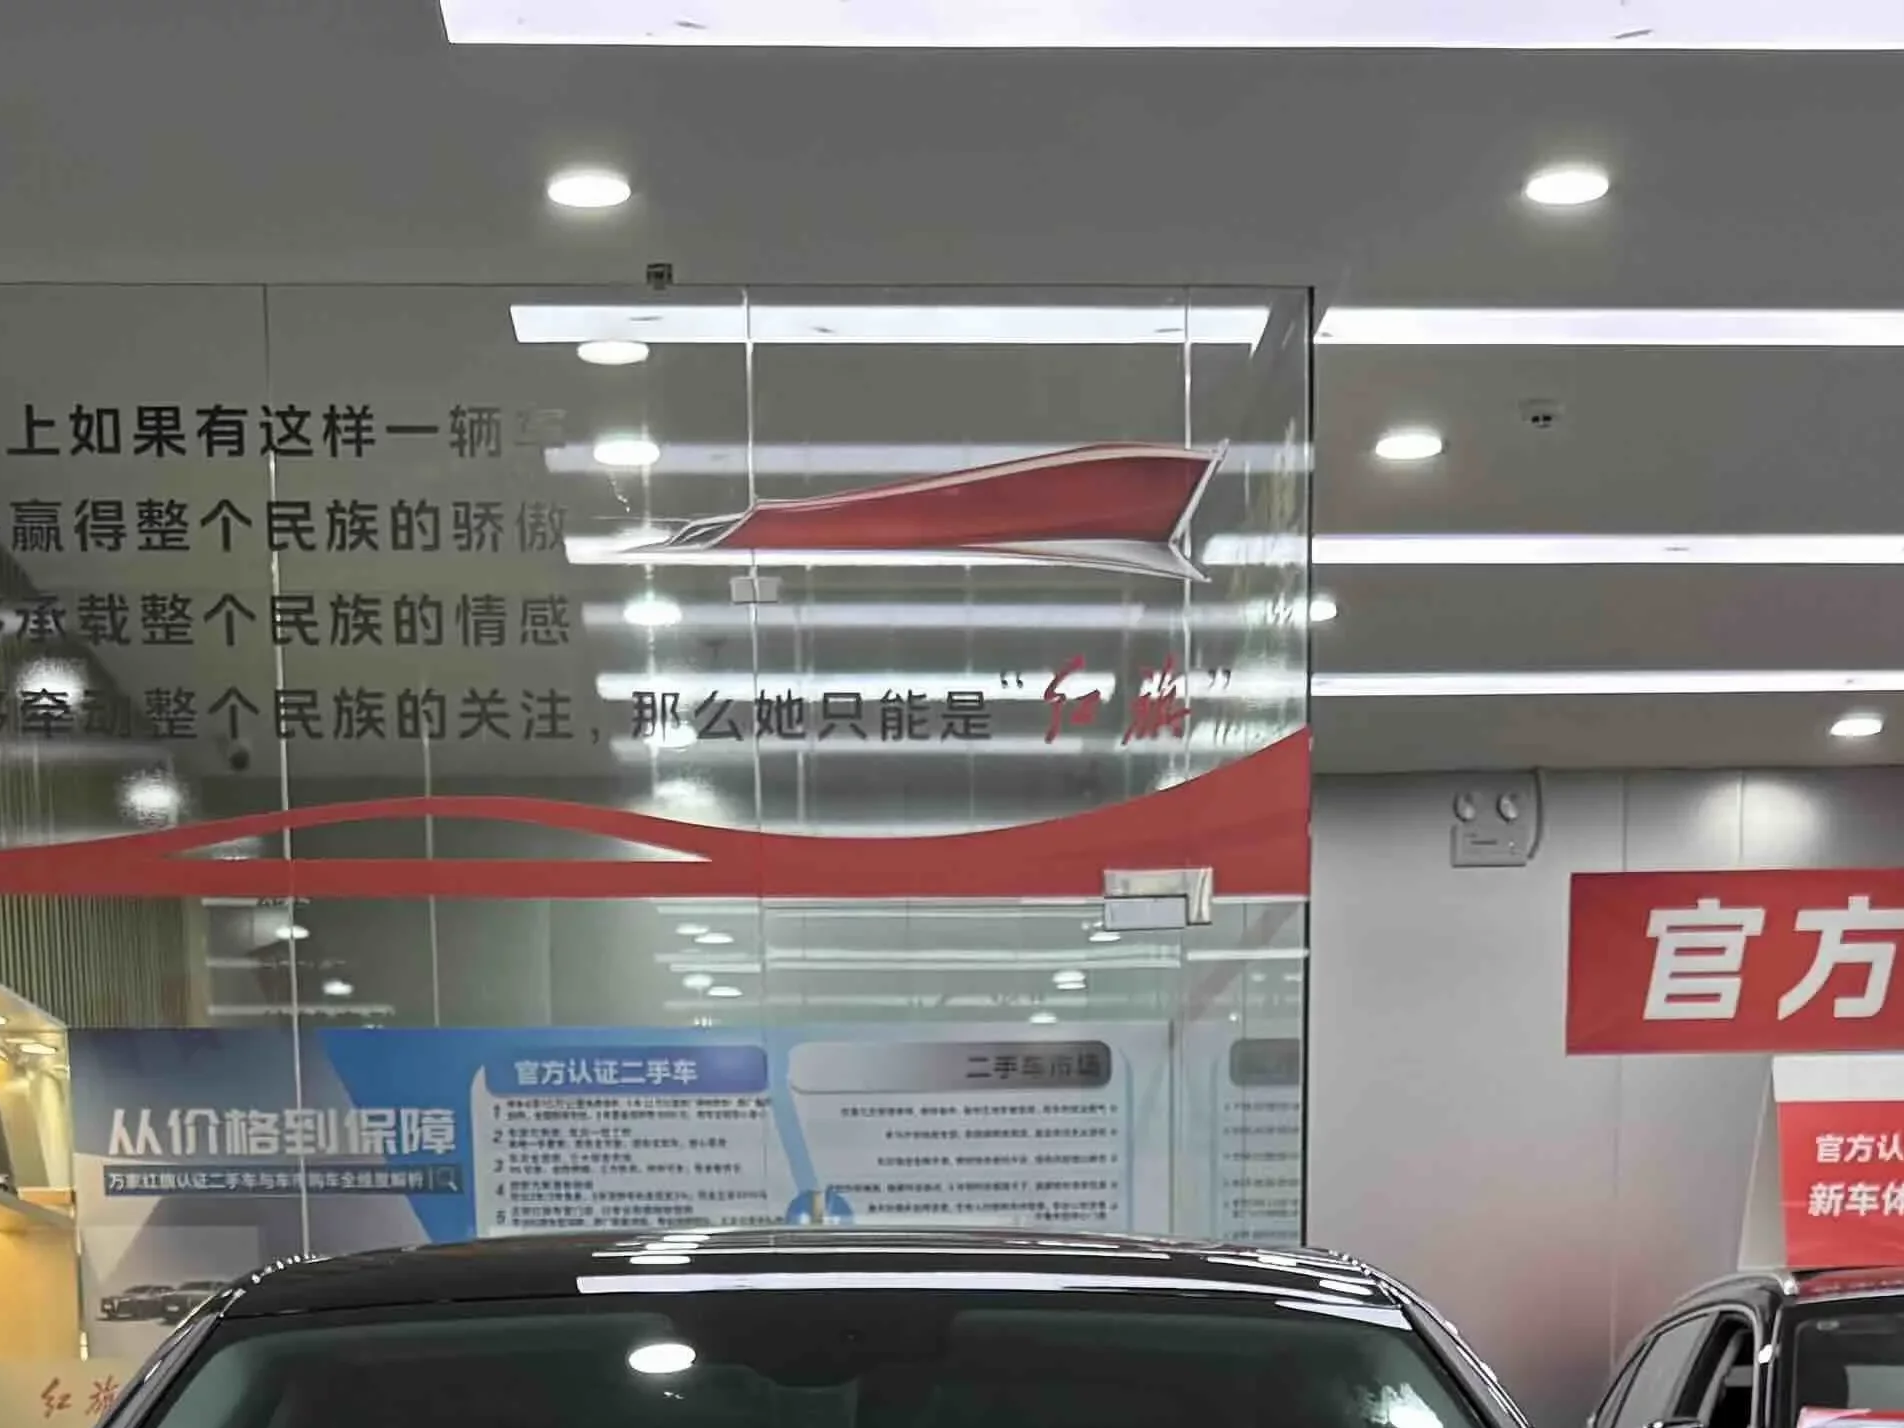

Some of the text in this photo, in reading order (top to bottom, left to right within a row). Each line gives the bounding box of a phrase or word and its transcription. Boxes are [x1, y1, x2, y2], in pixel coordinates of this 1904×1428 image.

[514, 1058, 698, 1086] 官方认证二手车
[108, 1108, 457, 1156] 从价格到保障
